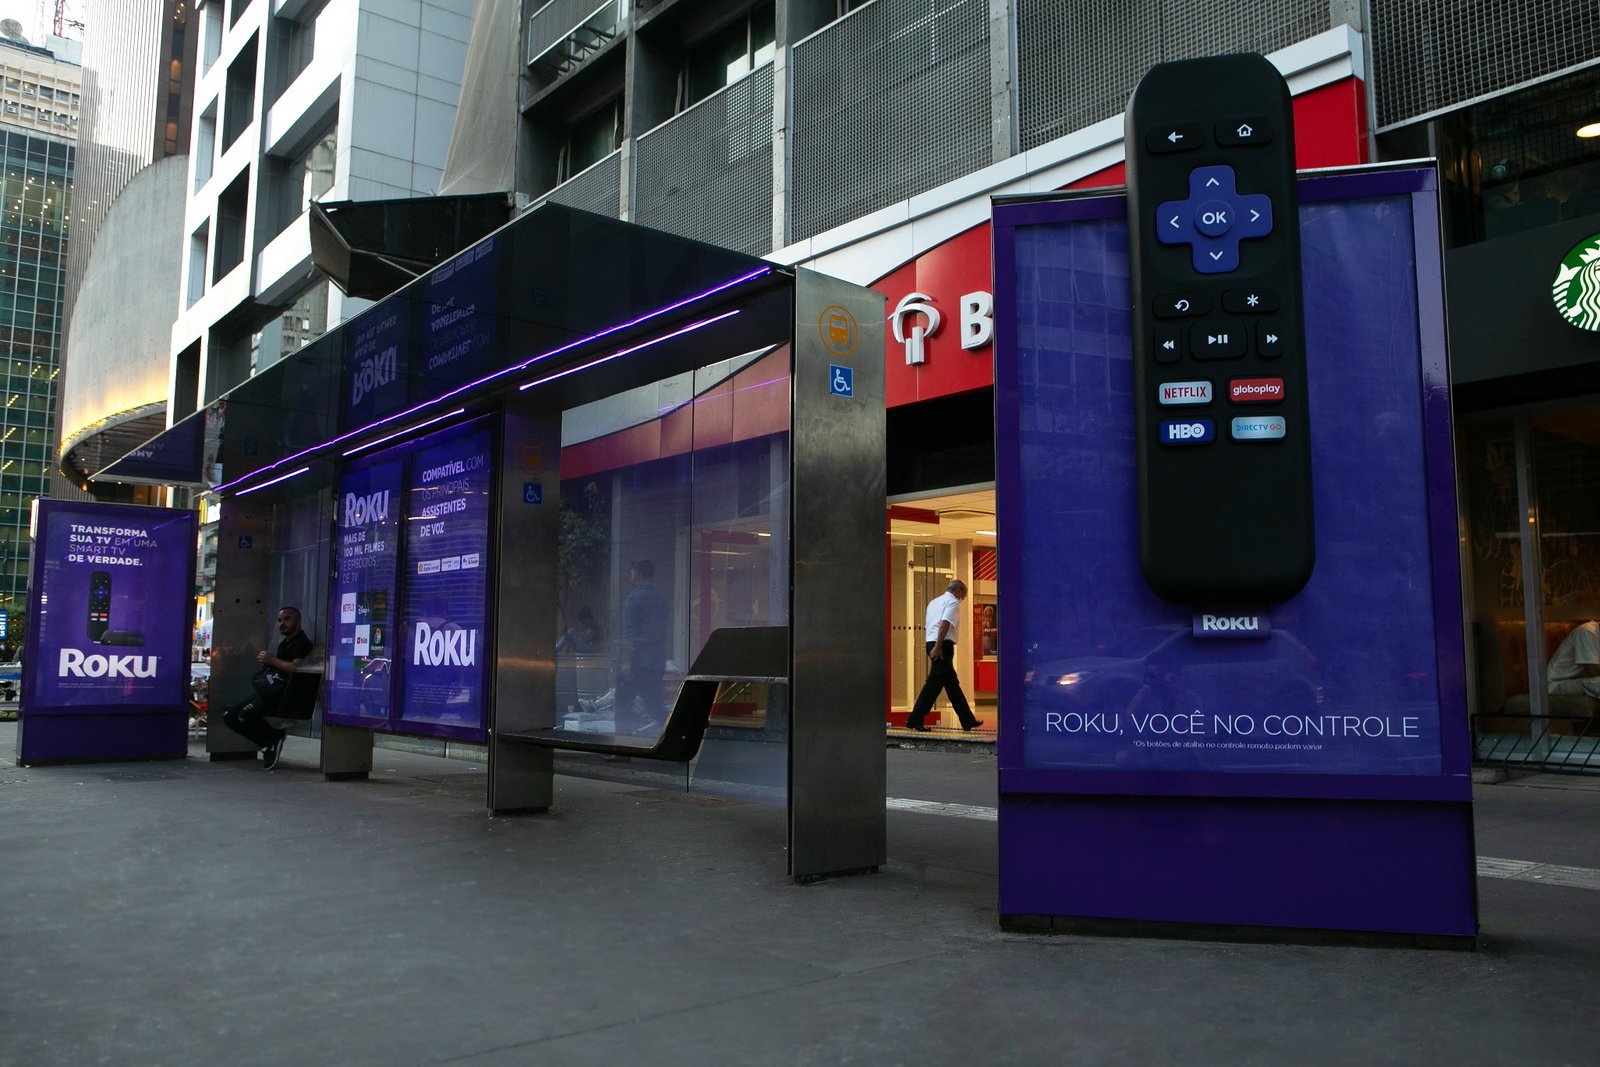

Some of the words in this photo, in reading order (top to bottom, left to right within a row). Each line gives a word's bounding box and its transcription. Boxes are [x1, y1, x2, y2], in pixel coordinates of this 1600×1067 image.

[1202, 211, 1227, 225] OK
[1164, 386, 1207, 399] NETFLIX
[1233, 384, 1281, 396] globoplay
[1169, 423, 1205, 439] HBO
[422, 460, 465, 482] COMPATÍVEL
[466, 455, 484, 471] COM
[422, 498, 466, 517] ASSISTENTES
[71, 524, 148, 538] TRANSFORMA
[420, 525, 431, 537] DE
[431, 521, 445, 535] VOZ
[70, 534, 93, 543] SUA
[96, 536, 111, 544] TV
[115, 537, 130, 546] EM
[133, 539, 158, 548] UMA
[344, 533, 357, 545] MAIS
[359, 531, 366, 542] DE
[70, 544, 108, 554] SMART
[110, 546, 126, 555] TV
[364, 540, 385, 554] FILMES
[68, 554, 84, 562] DE
[87, 555, 143, 566] VERDADE.
[1046, 712, 1123, 735] ROKU,
[1131, 709, 1205, 734] VOCÊ
[1214, 714, 1255, 736] NO
[1263, 714, 1420, 737] CONTROLE
[1146, 740, 1171, 748] botões
[1171, 740, 1181, 748] de
[1216, 741, 1246, 749] controle
[1274, 742, 1301, 751] podem
